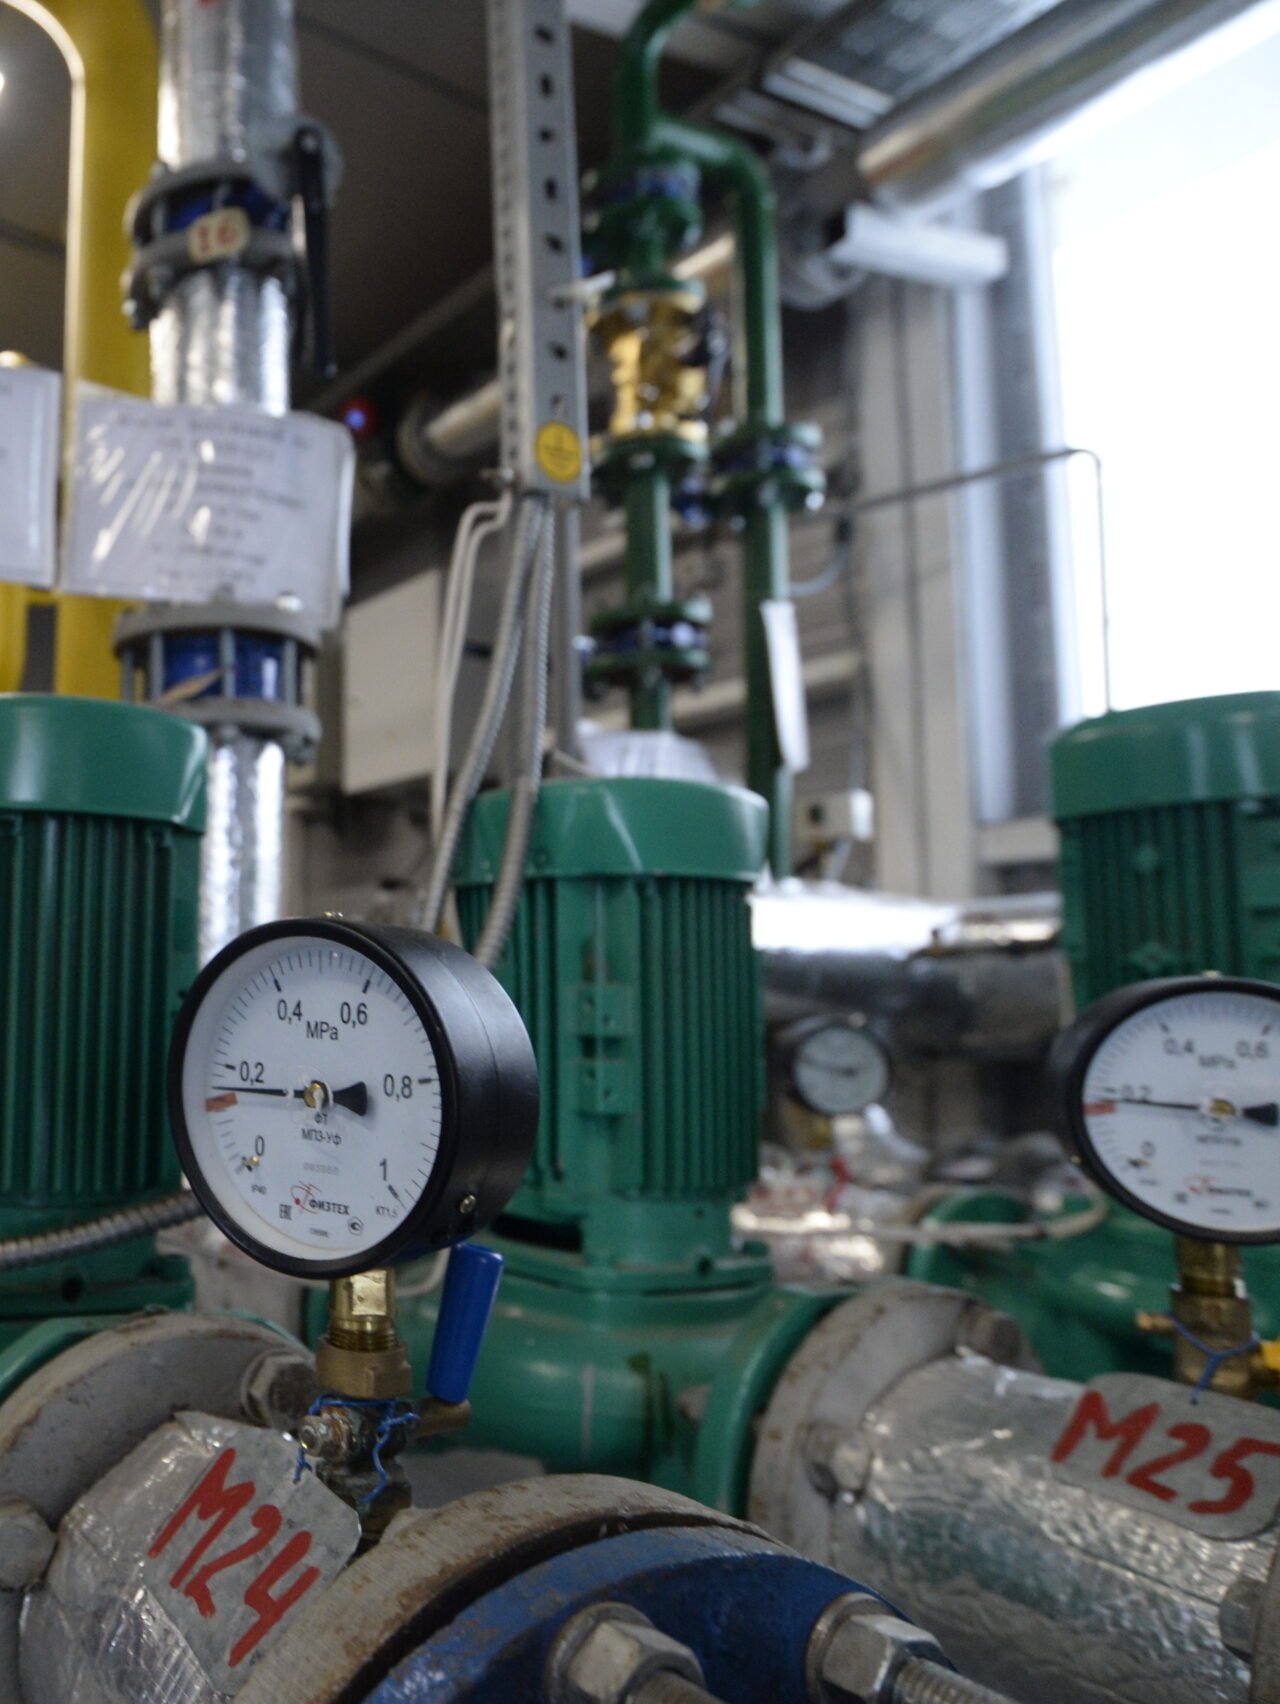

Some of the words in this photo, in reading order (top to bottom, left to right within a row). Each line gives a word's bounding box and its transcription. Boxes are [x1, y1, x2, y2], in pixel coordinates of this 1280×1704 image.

[277, 1000, 303, 1024] 0,4
[340, 1003, 368, 1028] 0,6
[306, 1021, 339, 1041] MPa
[239, 1062, 265, 1085] 0,2
[383, 1074, 413, 1099] 0,8
[255, 1135, 265, 1156] 0
[379, 1158, 388, 1182] 1
[308, 1199, 350, 1216] ФИЗТЕХ
[1051, 1390, 1280, 1514] M25
[147, 1447, 320, 1668] M24
